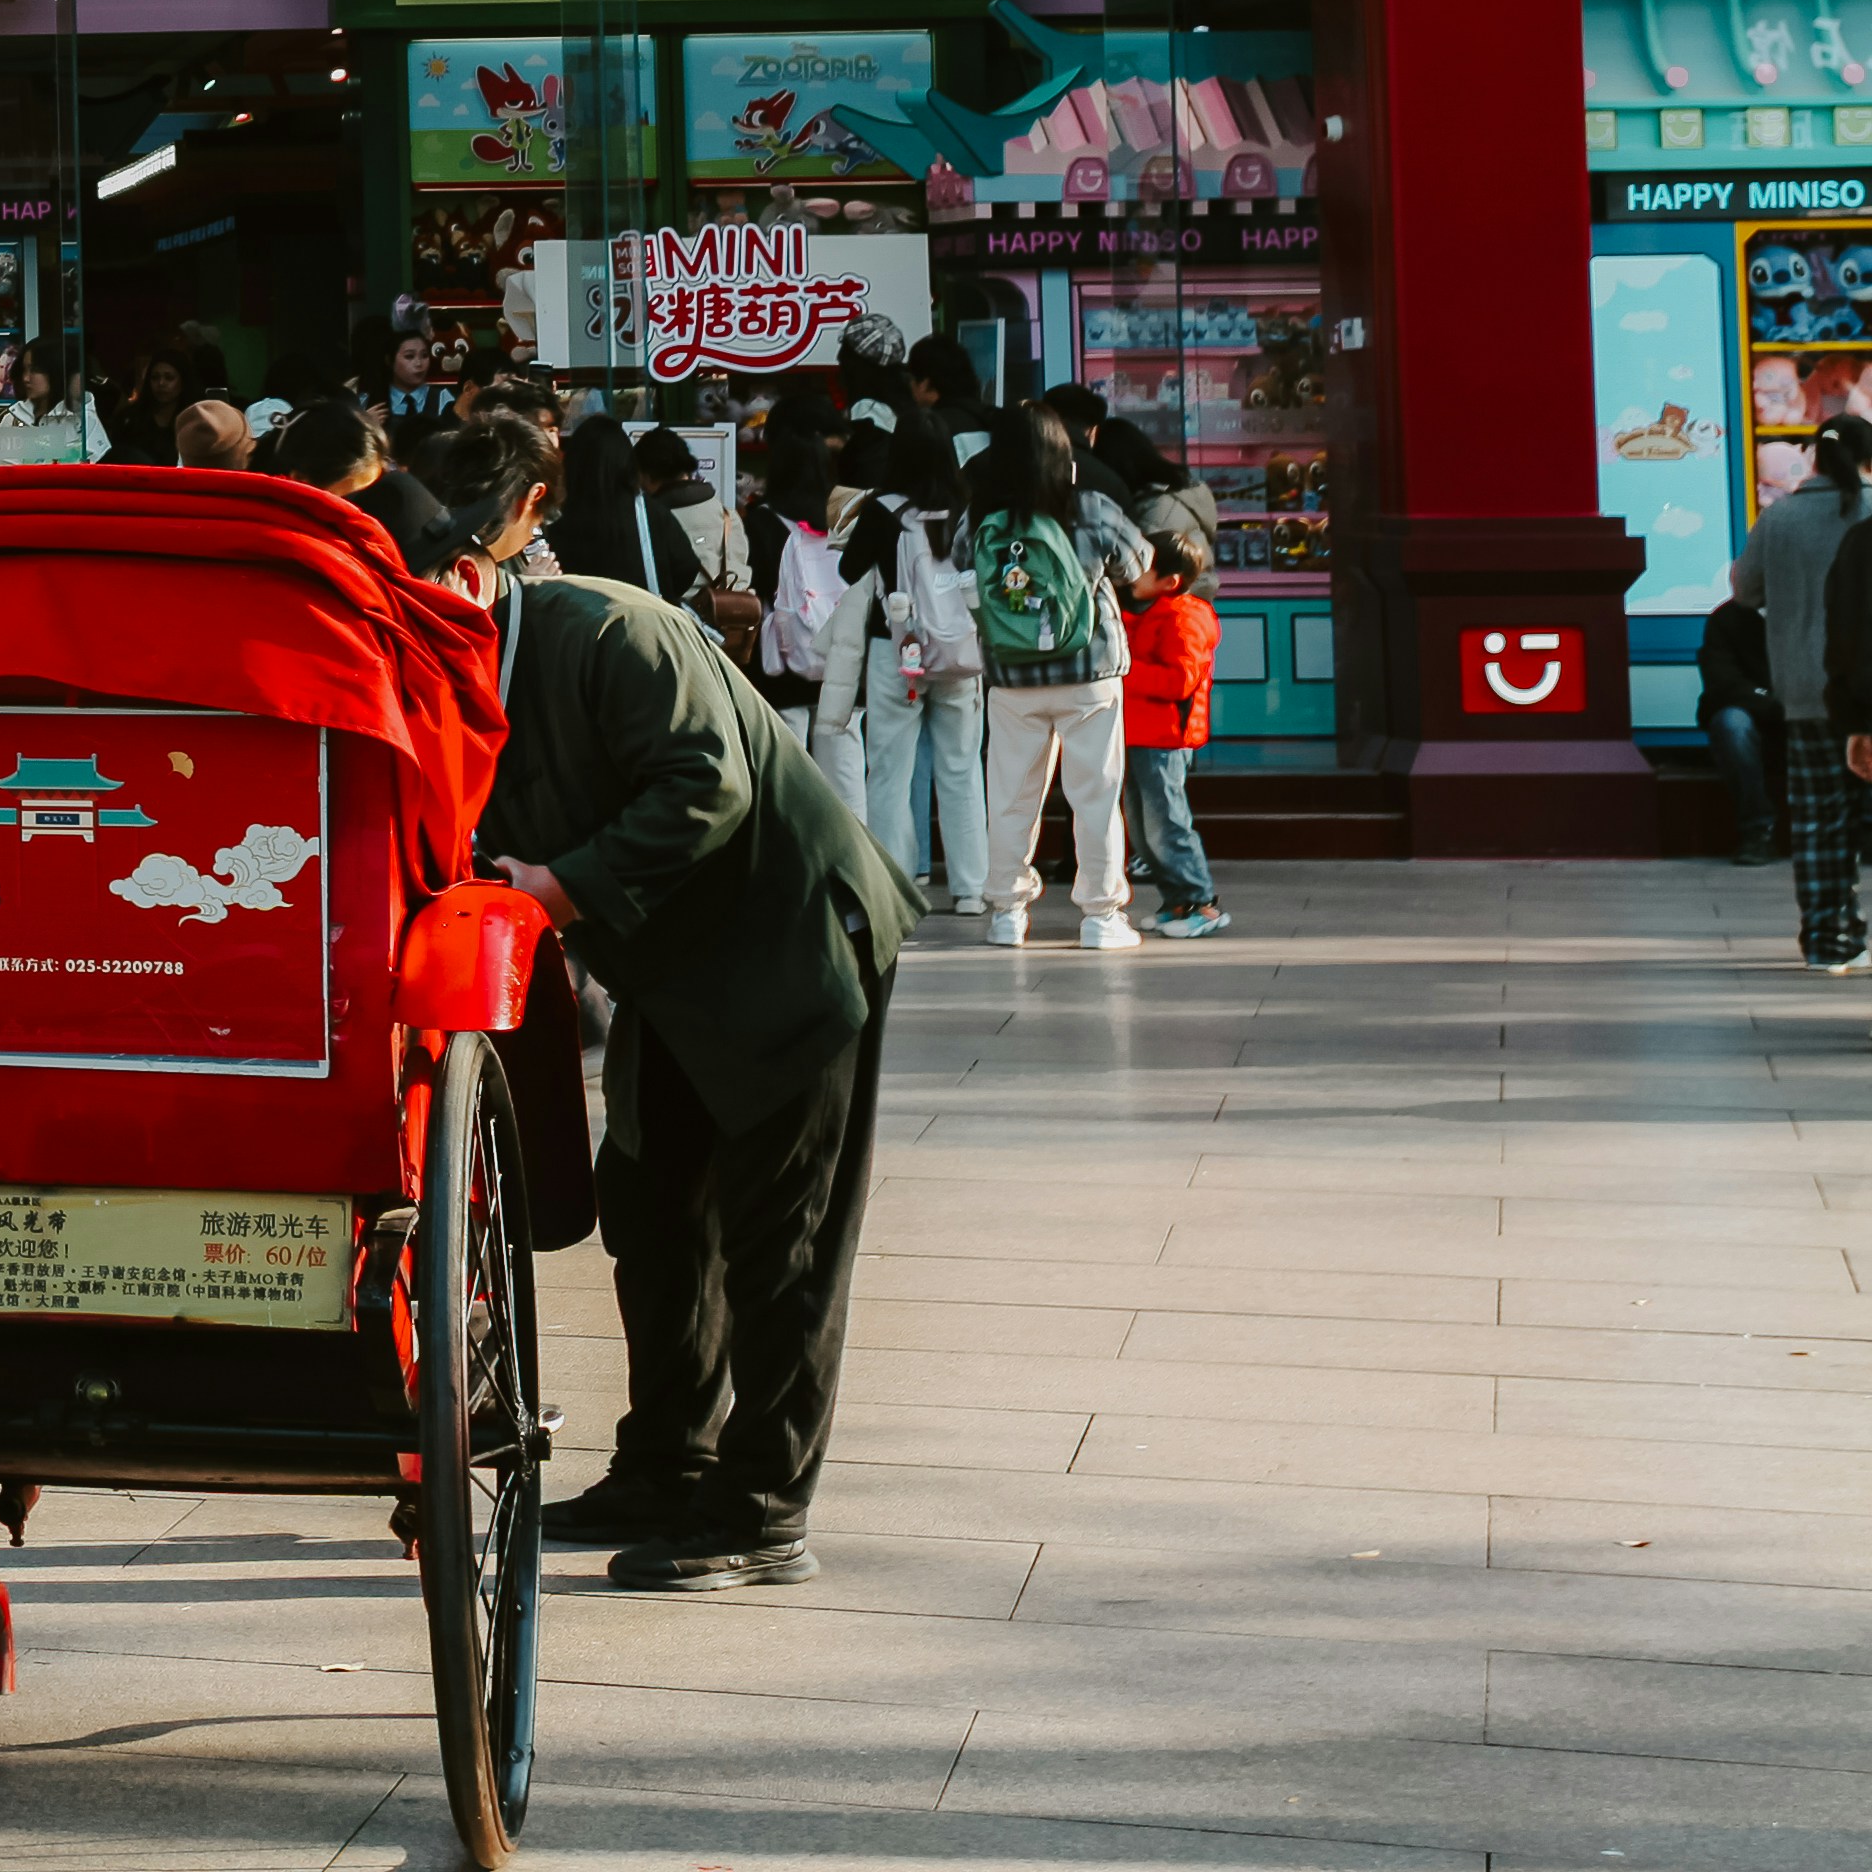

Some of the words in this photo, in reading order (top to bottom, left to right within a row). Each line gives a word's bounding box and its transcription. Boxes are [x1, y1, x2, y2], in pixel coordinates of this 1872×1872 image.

[1626, 181, 1735, 211] HAPPY
[1747, 179, 1867, 210] MINISO
[660, 224, 806, 280] MINI
[988, 231, 1083, 255] HAPPY
[65, 958, 184, 975] 025-52209788
[199, 1210, 330, 1240] 旅游观光车
[203, 1242, 251, 1265] 票价：
[265, 1244, 328, 1268] 60/位
